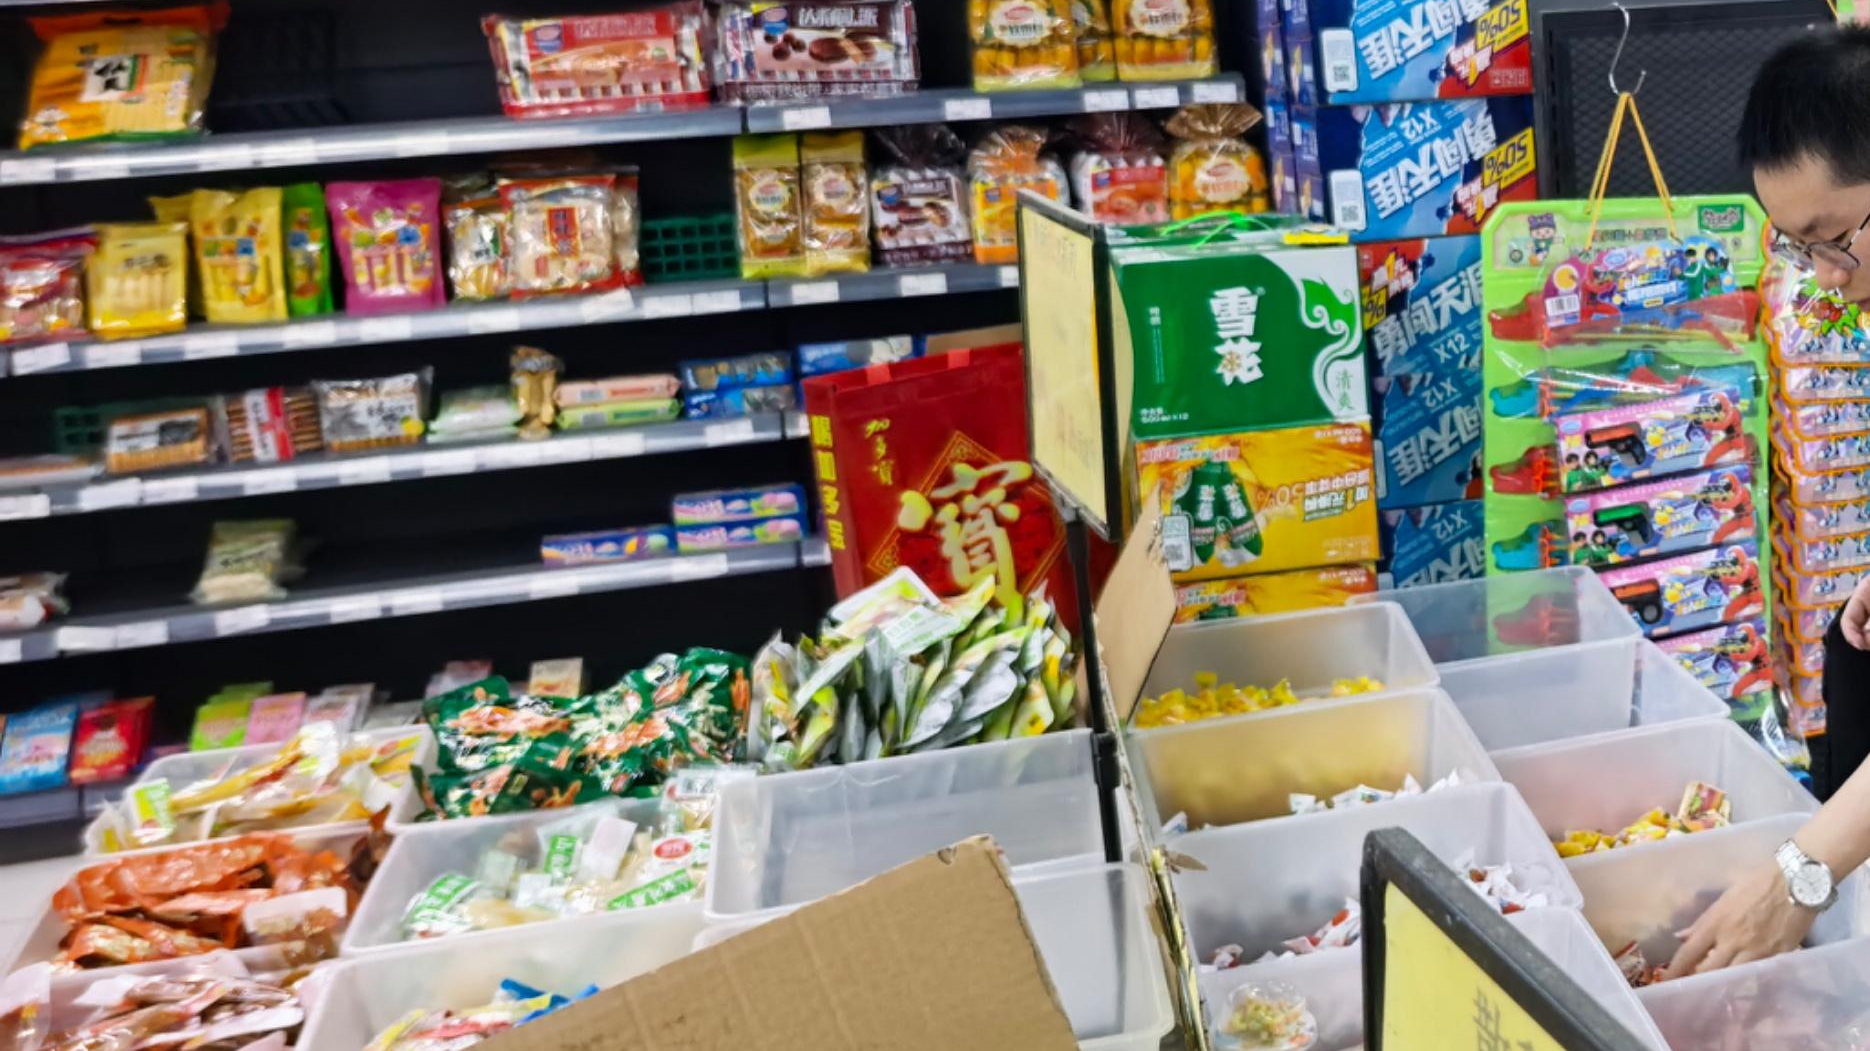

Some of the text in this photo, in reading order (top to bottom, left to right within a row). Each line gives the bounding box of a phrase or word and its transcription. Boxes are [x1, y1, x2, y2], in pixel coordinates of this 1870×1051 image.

[1367, 114, 1497, 220] 勇闯天涯
[1208, 285, 1264, 387] 雪花
[1335, 368, 1356, 413] 清爽
